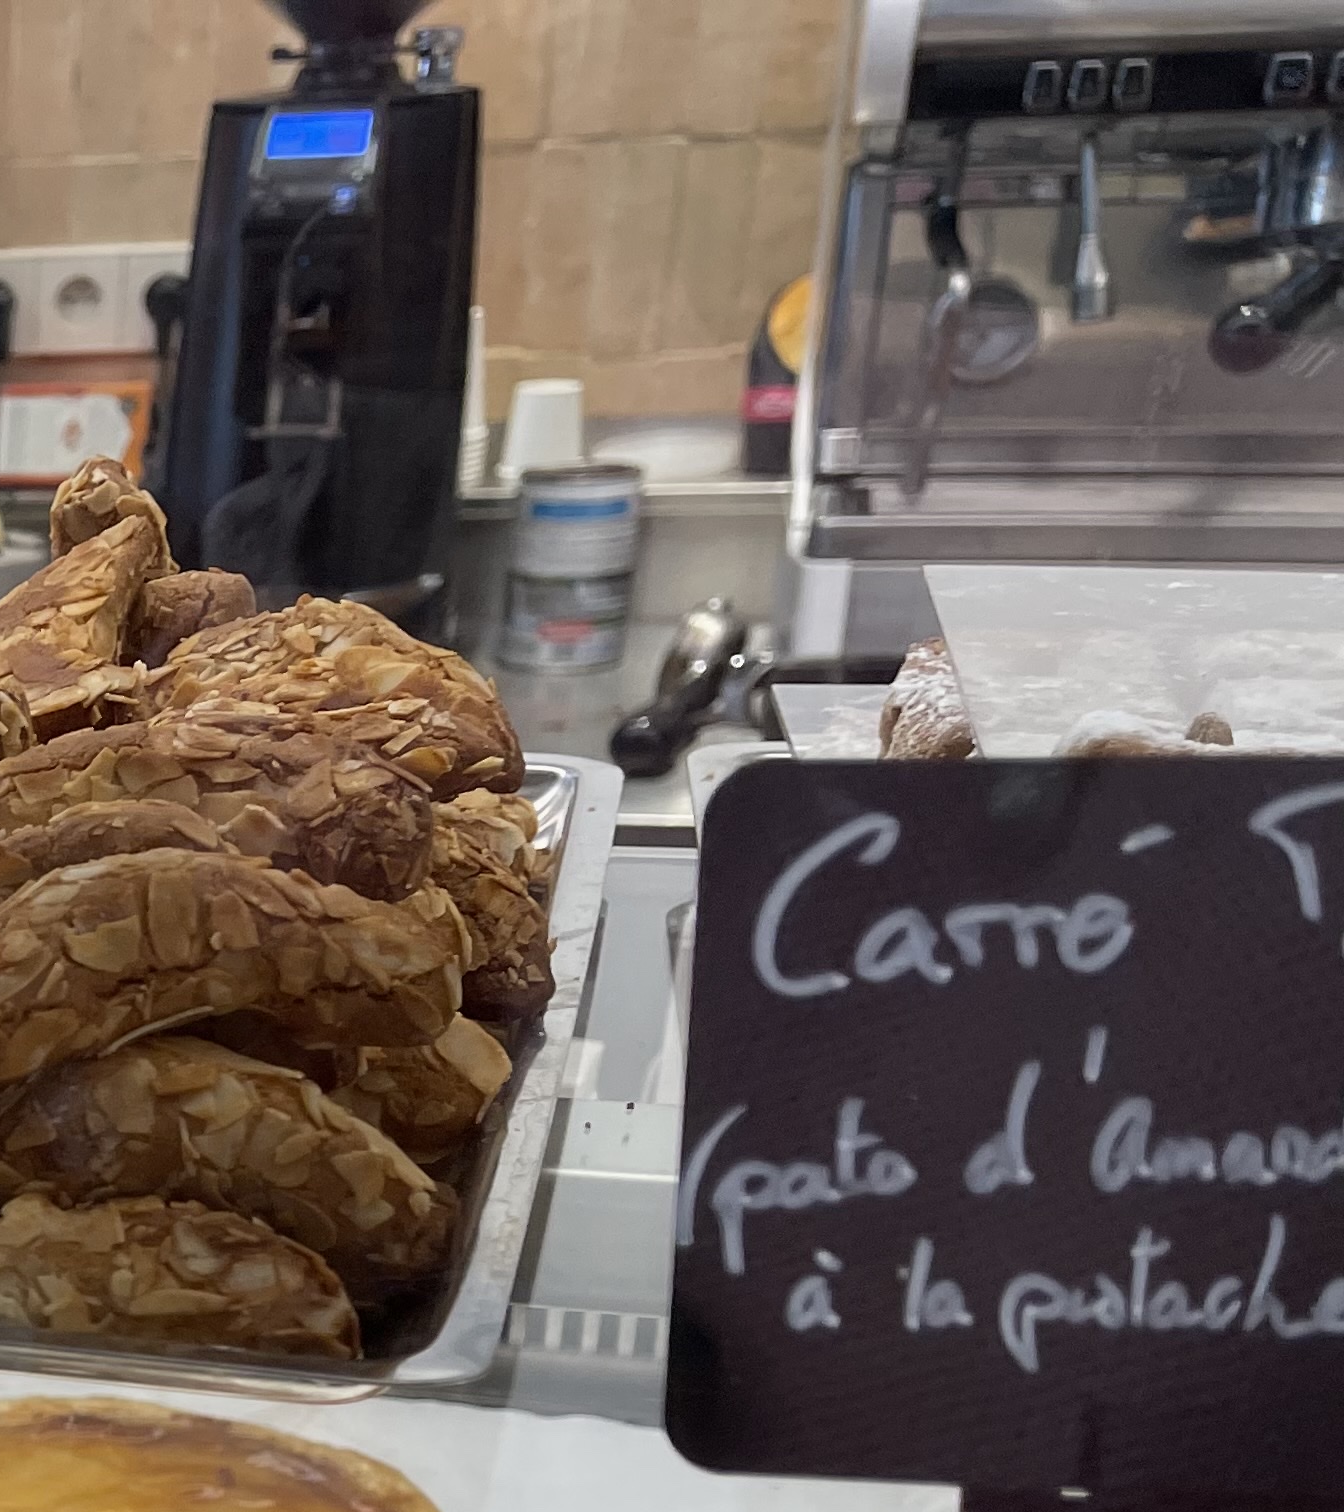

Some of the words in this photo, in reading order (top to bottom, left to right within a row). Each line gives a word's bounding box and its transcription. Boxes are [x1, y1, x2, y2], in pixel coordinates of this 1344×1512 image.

[752, 811, 1177, 998] Carré
[786, 1248, 843, 1332] à
[903, 1235, 975, 1332] la
